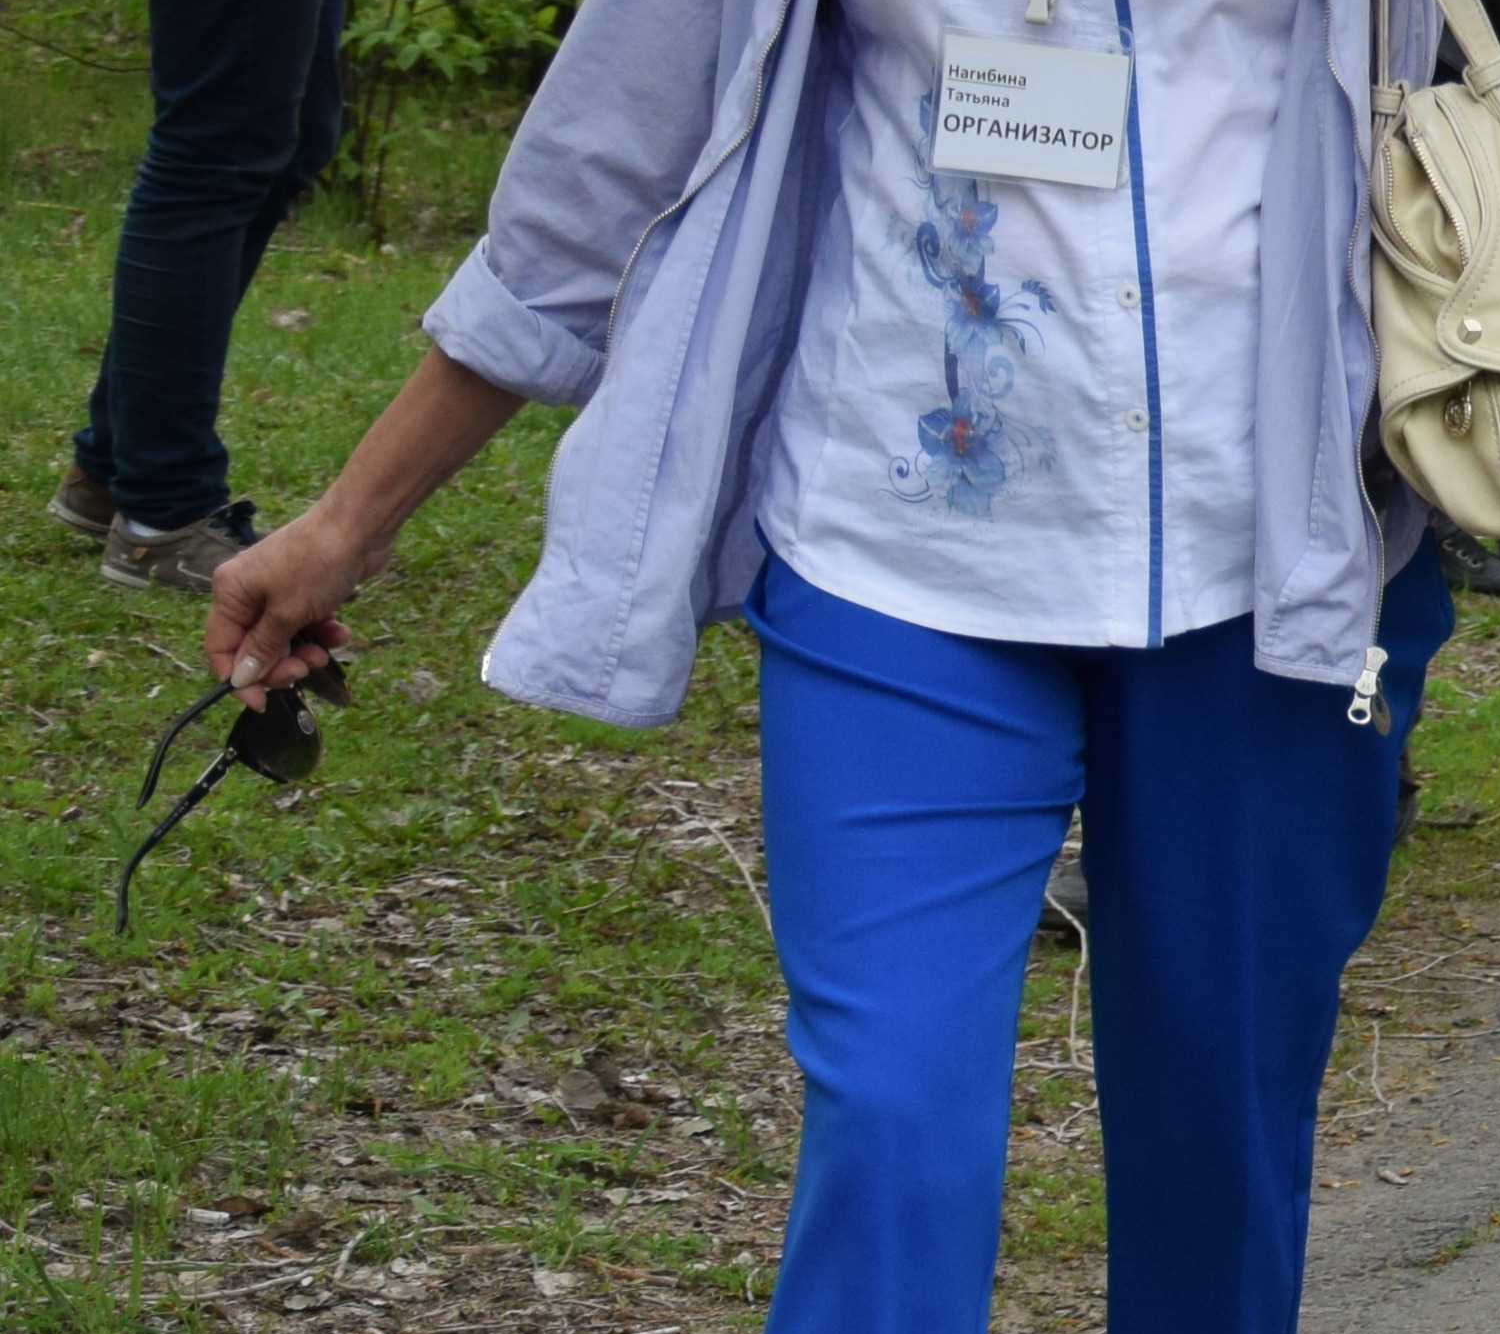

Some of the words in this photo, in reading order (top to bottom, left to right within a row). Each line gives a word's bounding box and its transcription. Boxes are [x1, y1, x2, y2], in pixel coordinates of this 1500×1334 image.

[948, 64, 1027, 88] Нагибина
[946, 87, 1010, 108] Татьяна
[943, 113, 1114, 152] ОРГАНИЗАТОР
